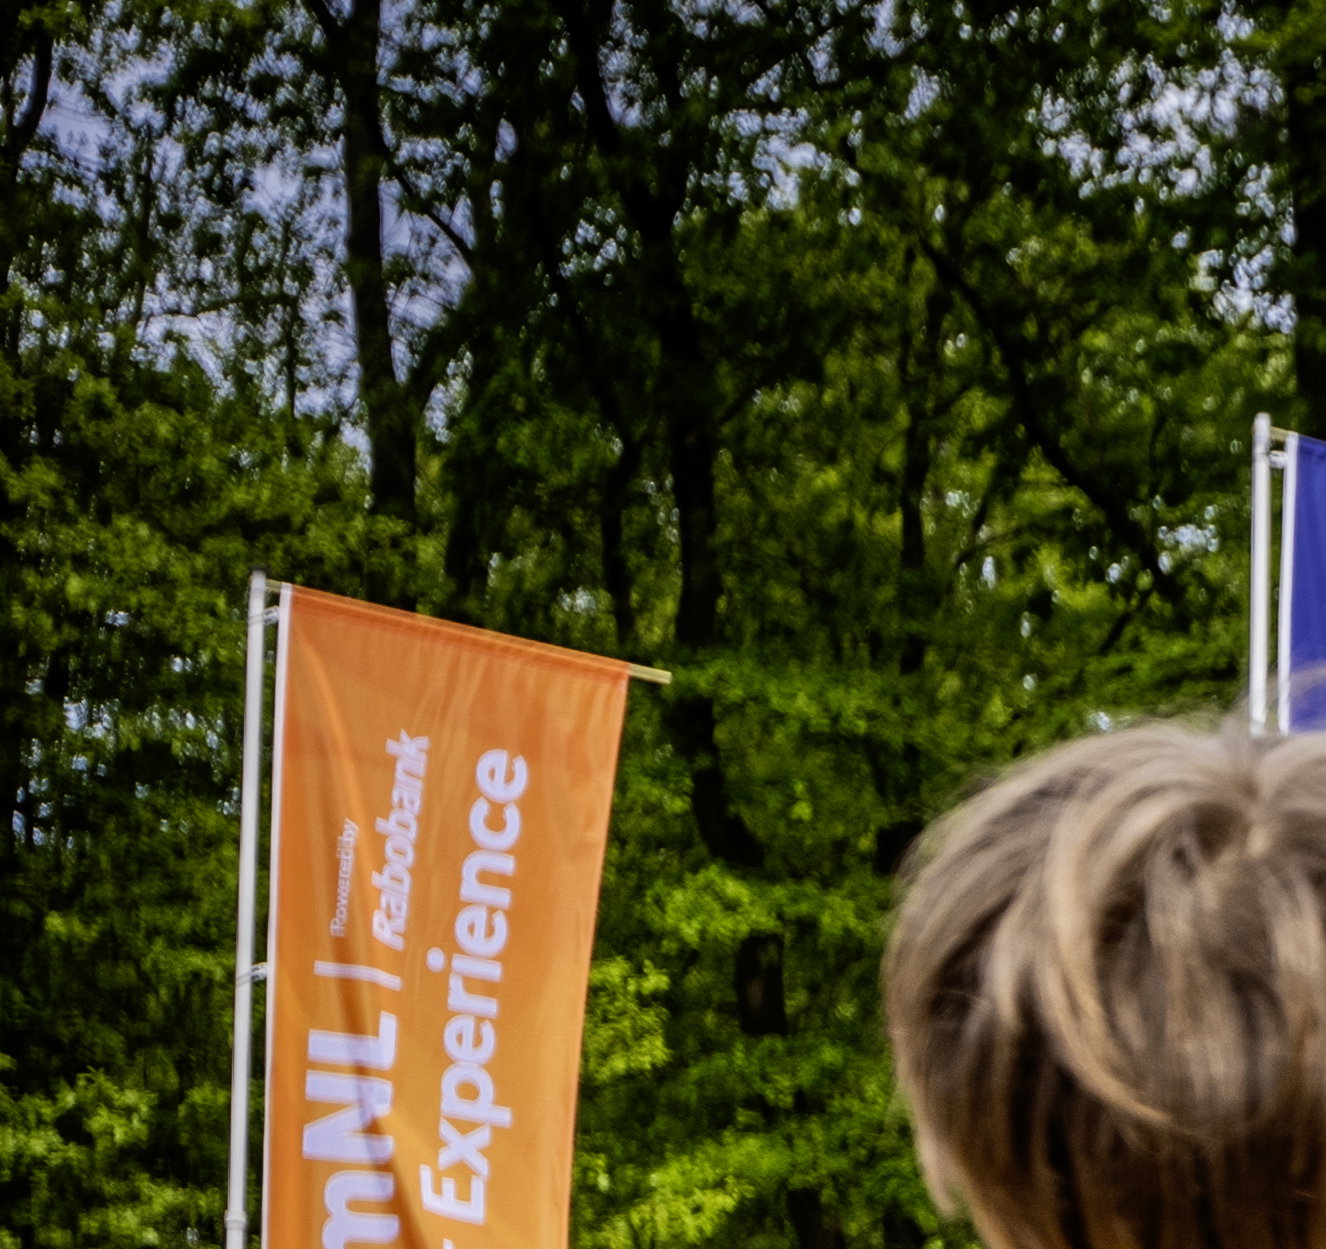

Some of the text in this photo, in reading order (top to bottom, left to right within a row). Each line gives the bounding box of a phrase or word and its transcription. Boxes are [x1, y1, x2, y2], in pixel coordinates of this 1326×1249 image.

[327, 818, 361, 938] Powered by
[373, 728, 430, 952] Rabobank
[419, 748, 528, 1225] Experience
